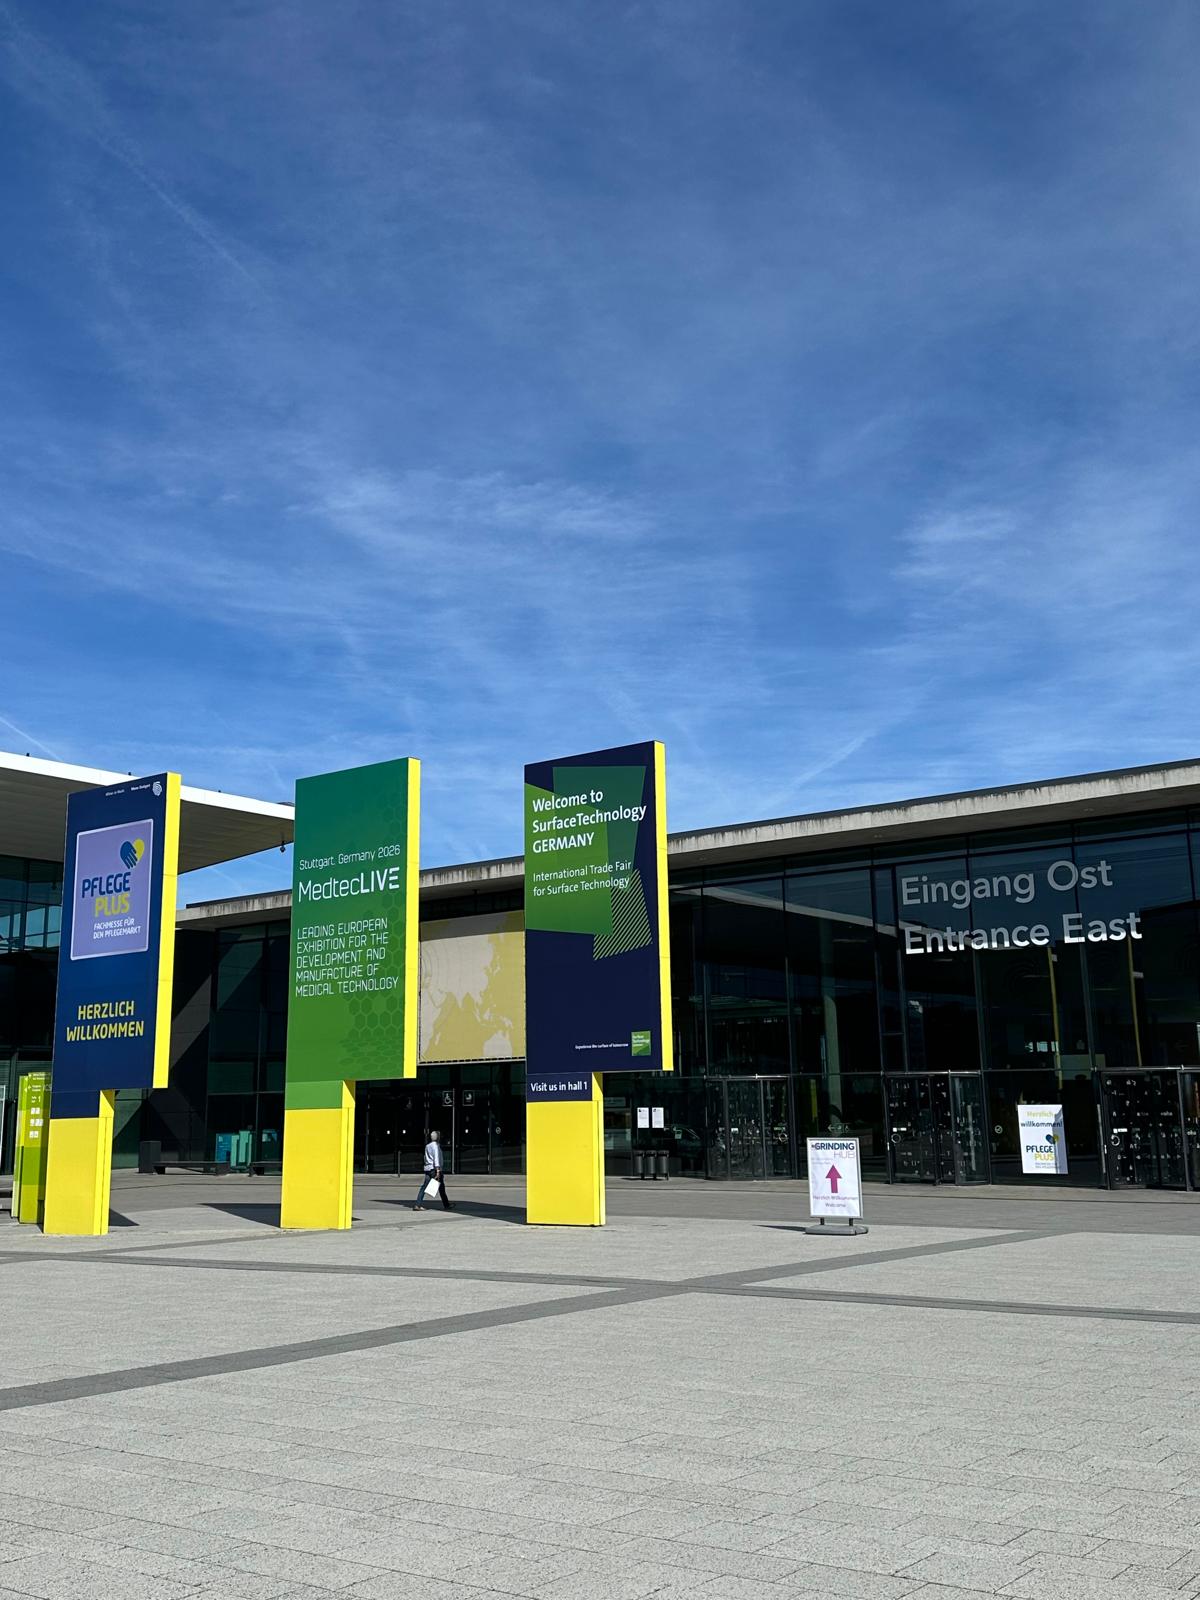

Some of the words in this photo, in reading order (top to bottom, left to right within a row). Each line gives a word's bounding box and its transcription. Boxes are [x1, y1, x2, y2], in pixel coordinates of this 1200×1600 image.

[532, 792, 588, 813] Welcome
[590, 789, 604, 803] to
[532, 805, 647, 833] SurfaceTechnology
[532, 832, 595, 853] GERMANY
[338, 850, 375, 865] Germany
[378, 844, 400, 858] 2026
[533, 865, 588, 882] International
[590, 861, 613, 874] Trade
[615, 859, 632, 871] Fair
[81, 872, 132, 898] PFLEGE
[298, 866, 400, 903] MedtecLIVE
[533, 885, 546, 897] for
[547, 882, 578, 896] Surface
[580, 875, 630, 890] Technology
[901, 872, 1036, 909] Eingang
[1047, 860, 1113, 891] Ost
[94, 893, 131, 918] PLUS
[93, 931, 104, 939] DEN
[104, 925, 141, 938] PFLEGEMARKT
[94, 919, 124, 931] FACHMESSE
[123, 916, 135, 927] FÜR
[297, 924, 335, 940] LEADING
[338, 917, 388, 935] EUROPEAN
[904, 923, 1050, 955] Entrance
[1062, 912, 1143, 944] East
[296, 937, 345, 954] EXHIBITION
[348, 934, 367, 948] FOR
[370, 932, 389, 946] THE
[296, 950, 363, 969] DEVELOPMENT
[366, 947, 386, 961] AND
[296, 964, 363, 983] MANUFACTURE
[367, 963, 380, 976] OF
[295, 983, 334, 997] MEDICAL
[337, 976, 399, 993] TECHNOLOGY
[78, 1000, 134, 1021] HERZLICH
[66, 1020, 144, 1042] WILLKOMMEN
[530, 1081, 547, 1092] Visit
[549, 1083, 558, 1092] us
[559, 1081, 567, 1091] in
[568, 1081, 582, 1091] hall
[583, 1081, 588, 1090] 1
[814, 1142, 855, 1150] GRINDING
[833, 1150, 855, 1159] HUB
[1025, 1145, 1054, 1153] PFLEGE
[1034, 1153, 1055, 1161] PLUS
